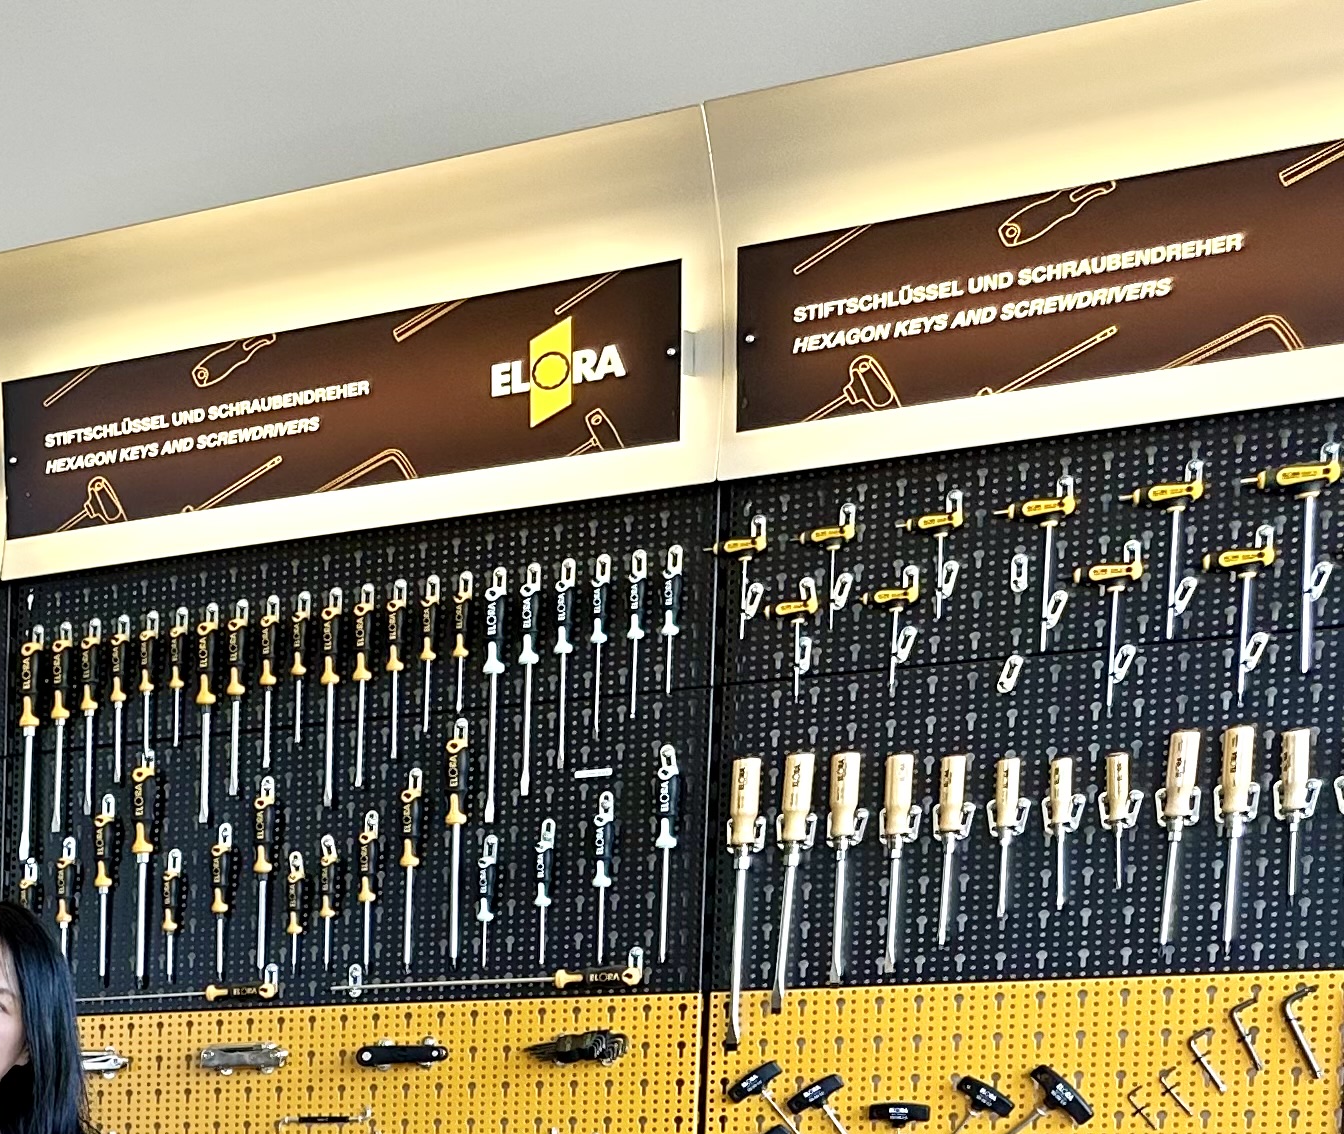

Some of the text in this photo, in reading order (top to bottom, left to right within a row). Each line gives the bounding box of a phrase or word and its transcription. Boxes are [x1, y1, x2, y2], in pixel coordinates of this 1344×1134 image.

[792, 233, 1244, 324] STIFTSCHLÜSSEL UND SCHRAUBENDREHER
[792, 277, 1173, 355] HEXAGON KEYS AND SCREWDRIVERS
[491, 343, 627, 398] ELORA
[44, 380, 370, 449] STIFTSCHLÜSSEL UND SCHRAUBENDREHER
[45, 416, 320, 475] HEXAGON KEYS AND SCREWDRIVERS
[487, 602, 496, 635] ELORA
[523, 598, 531, 629] ELORA
[356, 616, 364, 647] ELORA
[199, 636, 207, 668] ELORA
[23, 656, 31, 690] ELORA
[53, 652, 61, 685] ELORA
[450, 755, 458, 787] ELORA
[135, 784, 143, 816] ELORA
[660, 781, 669, 812] ELORA
[595, 826, 604, 855] ELORA
[589, 971, 620, 982] ELORA
